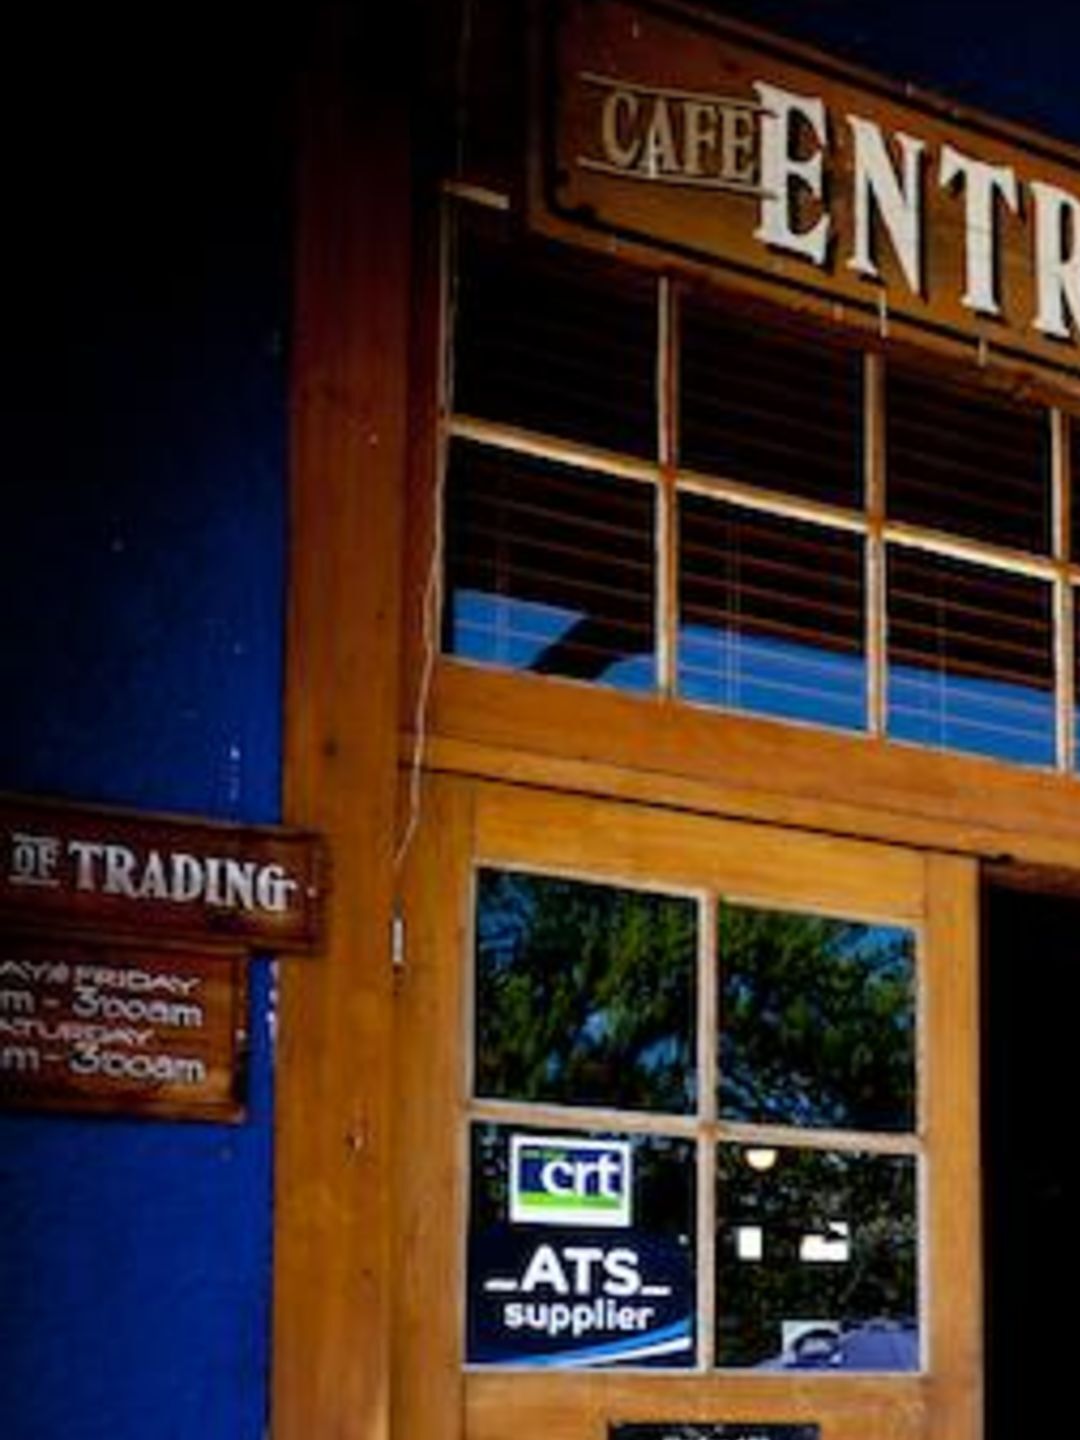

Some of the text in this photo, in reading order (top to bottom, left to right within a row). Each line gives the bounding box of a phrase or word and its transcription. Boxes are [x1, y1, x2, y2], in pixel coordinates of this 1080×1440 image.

[602, 90, 755, 180] CAFE
[11, 838, 297, 911] OF TRADING
[73, 964, 200, 998] FRIDAY
[540, 1152, 622, 1198] crt
[503, 1298, 656, 1339] supplier
